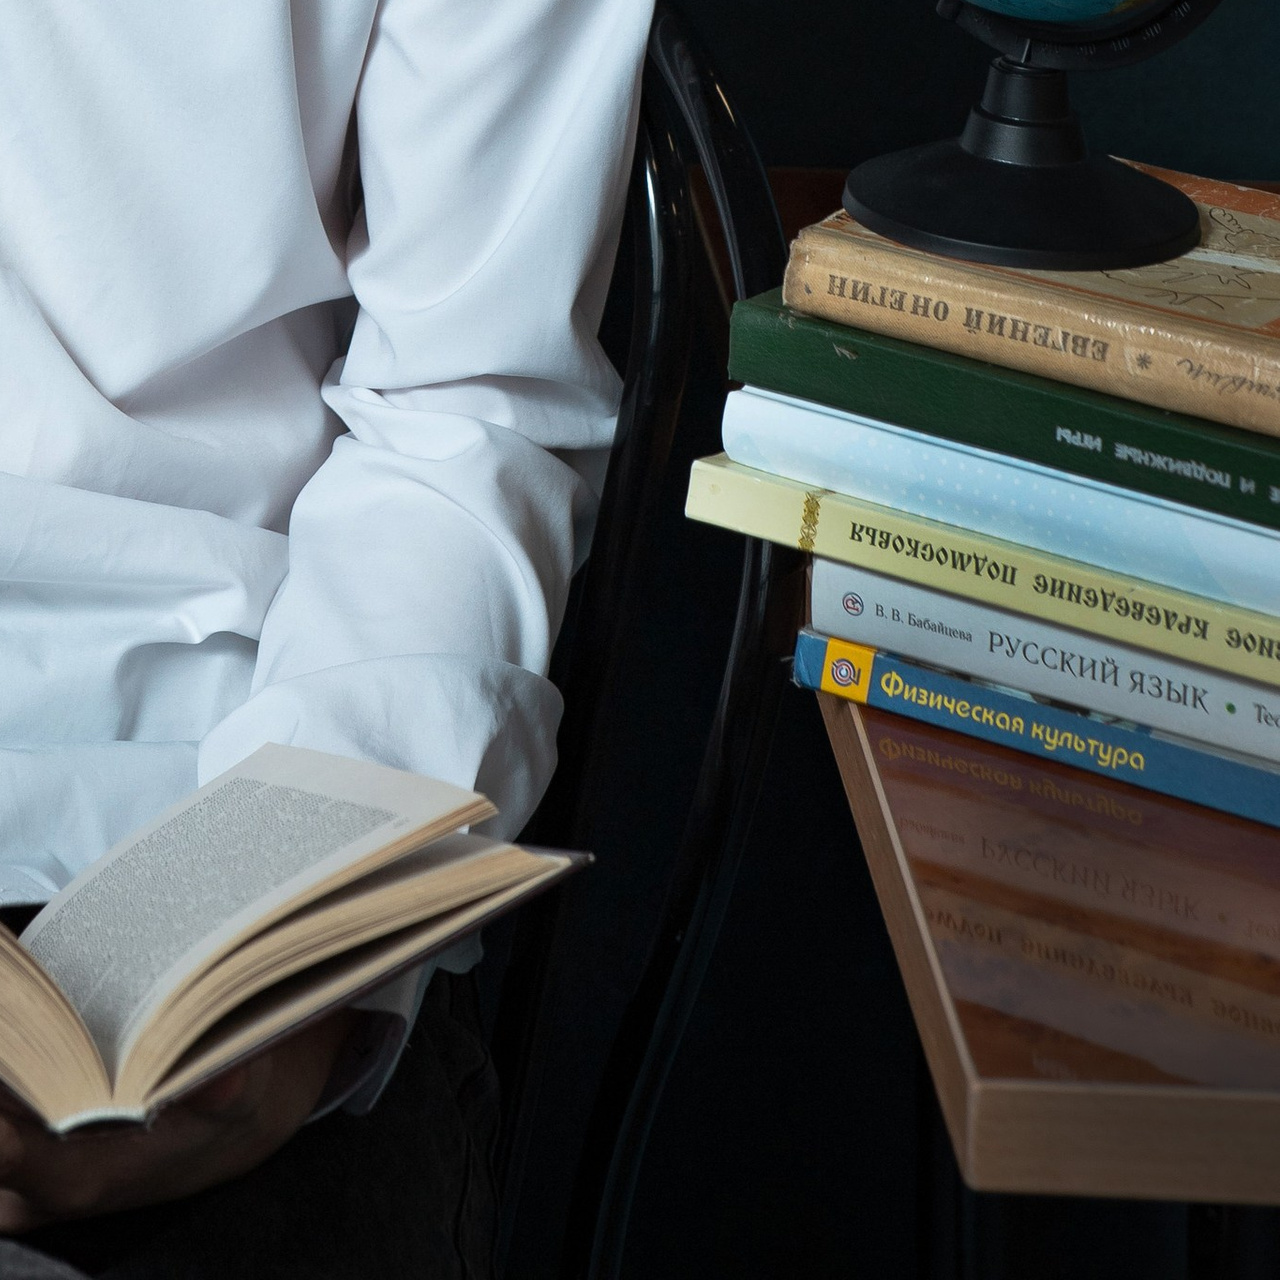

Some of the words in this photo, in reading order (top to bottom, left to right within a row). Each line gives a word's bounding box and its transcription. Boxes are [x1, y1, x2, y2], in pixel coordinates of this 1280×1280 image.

[827, 274, 950, 323] ОНЕГИН
[962, 306, 1110, 362] ЕВГЕНИЙ
[1055, 425, 1103, 453] ИГРЫ
[1113, 442, 1232, 489] ПОДВИЖНЫЕ
[1239, 476, 1255, 494] И
[875, 603, 888, 620] В.
[891, 607, 904, 624] В.
[908, 612, 973, 642] Бабайцева
[989, 630, 1120, 687] РУССКИЙ
[1130, 670, 1210, 713] ЯЗЫК
[880, 670, 1024, 735] Физическая
[1031, 720, 1145, 771] культура
